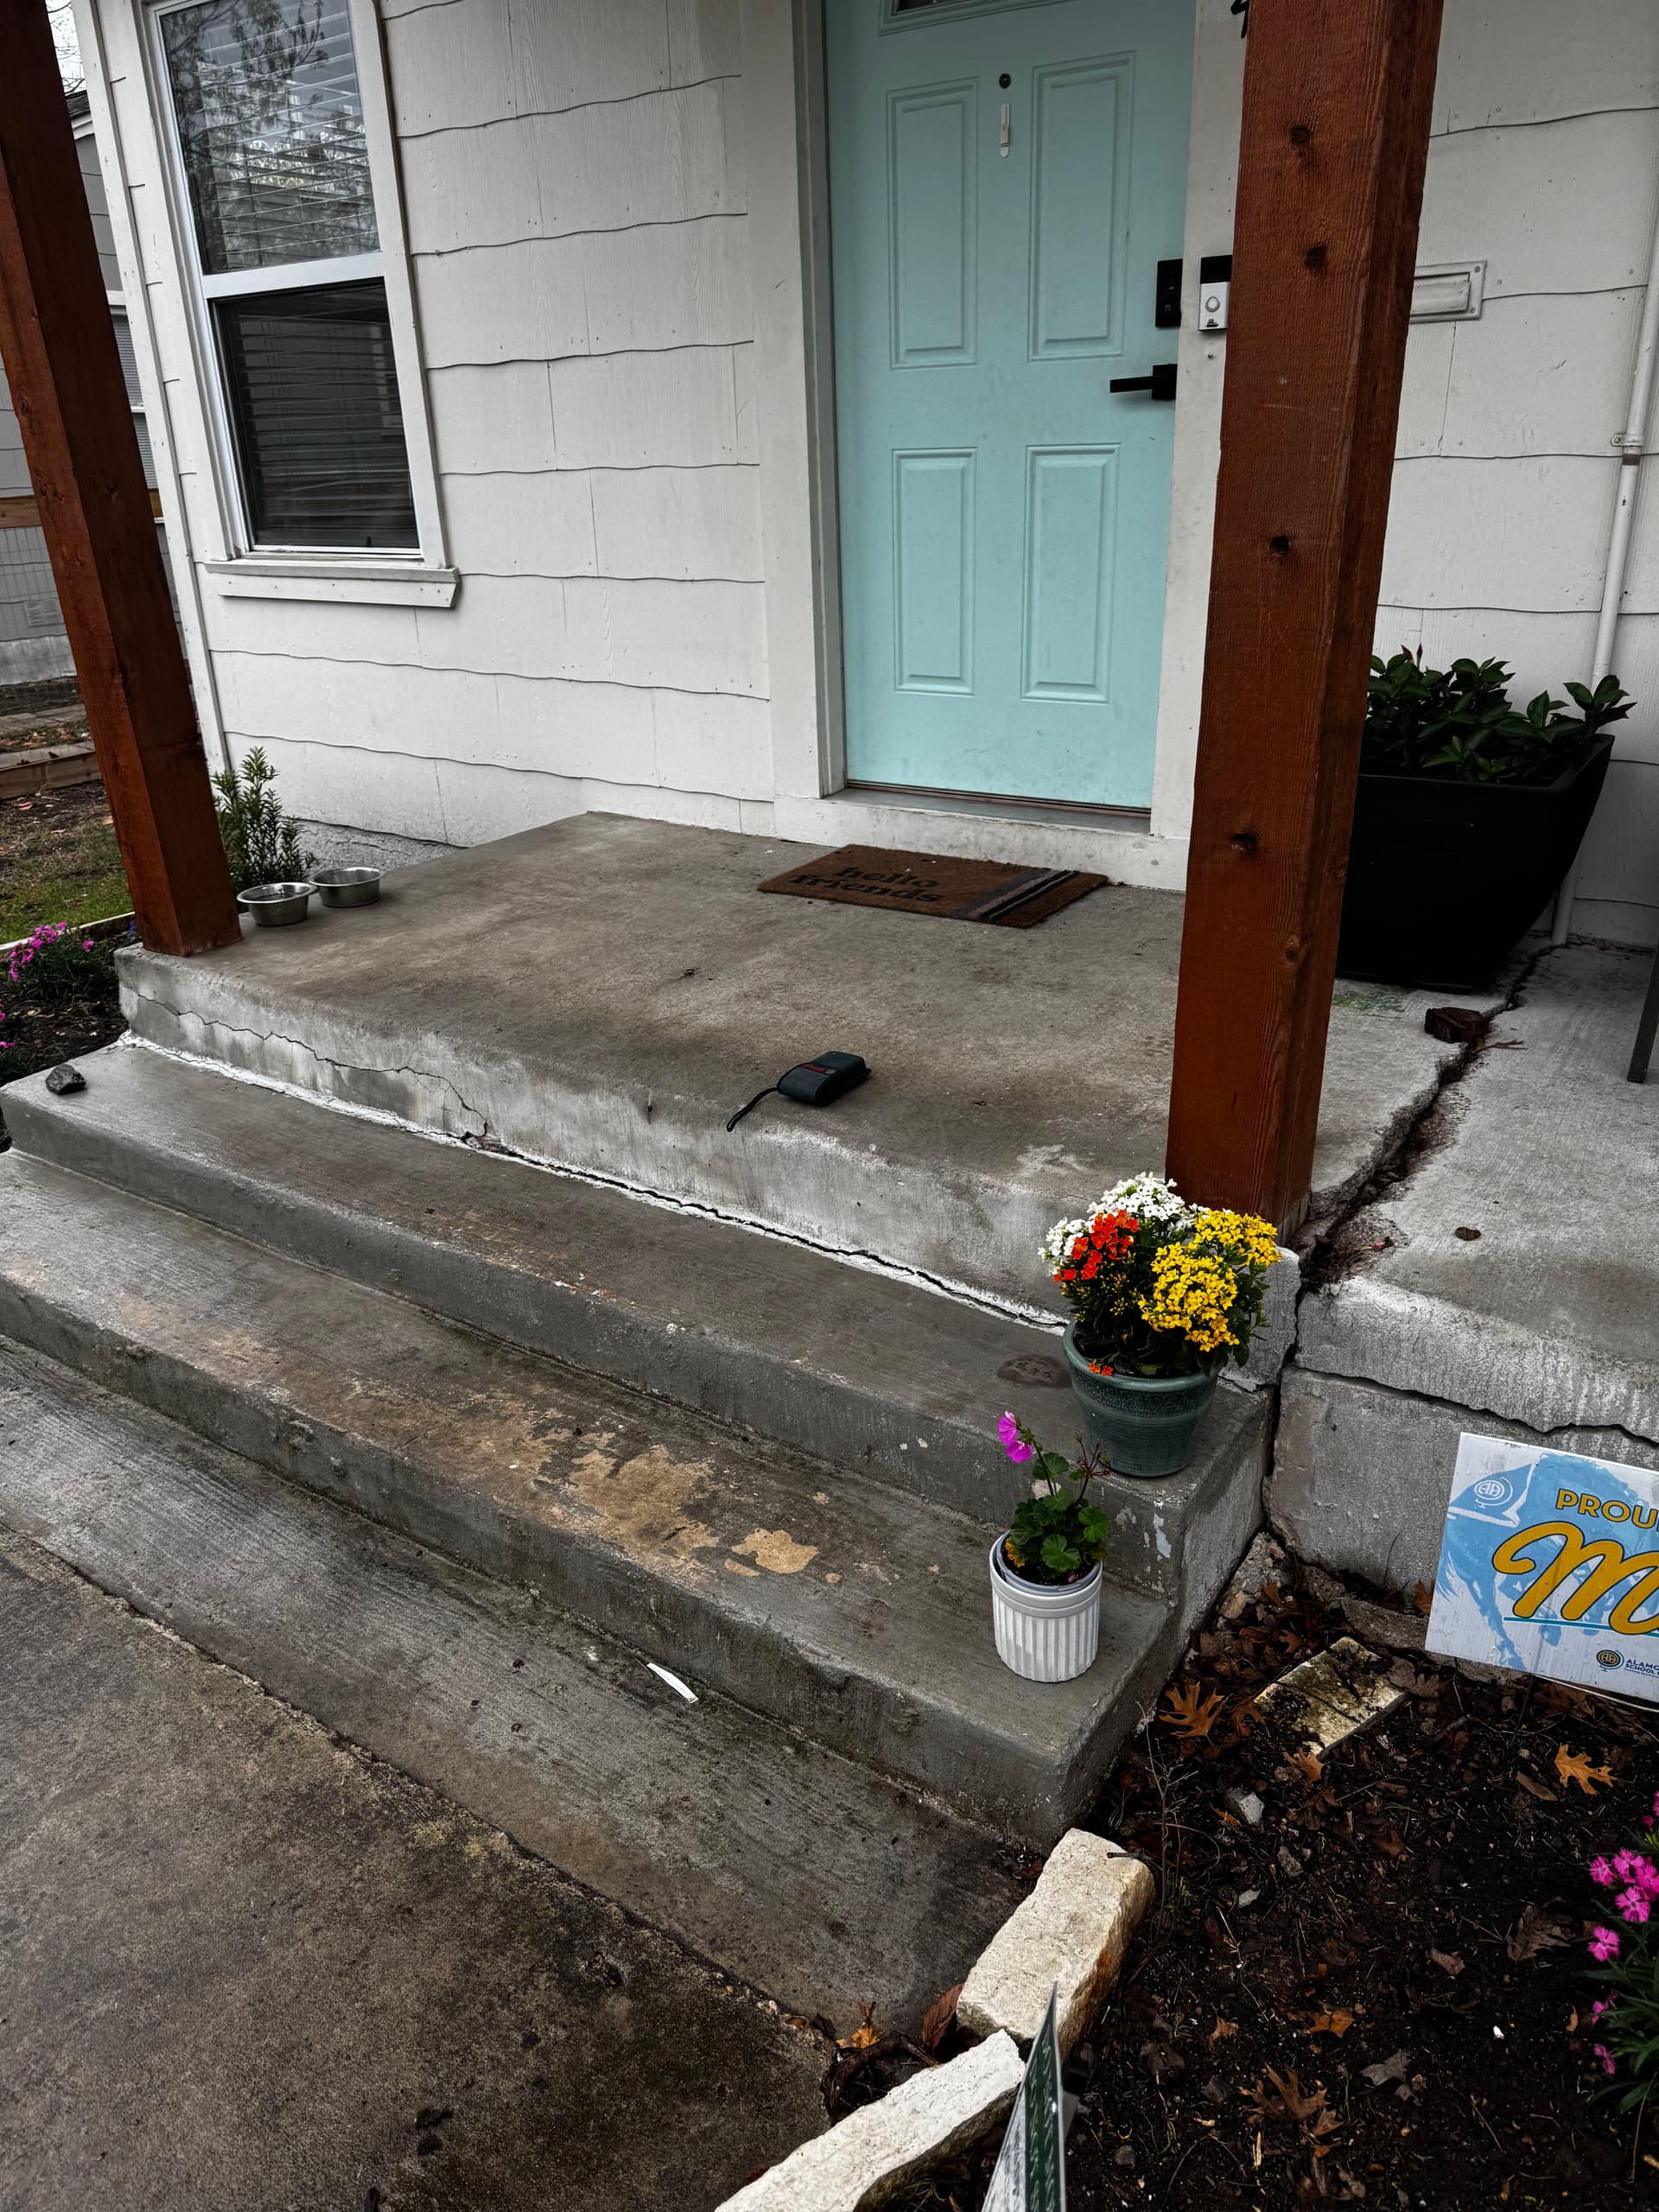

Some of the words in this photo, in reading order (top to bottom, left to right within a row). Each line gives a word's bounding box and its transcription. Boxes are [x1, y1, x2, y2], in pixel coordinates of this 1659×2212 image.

[787, 873, 944, 902] friends
[831, 867, 940, 888] hello
[1555, 1488, 1659, 1532] PROU
[1624, 1663, 1656, 1675] SCHOOL
